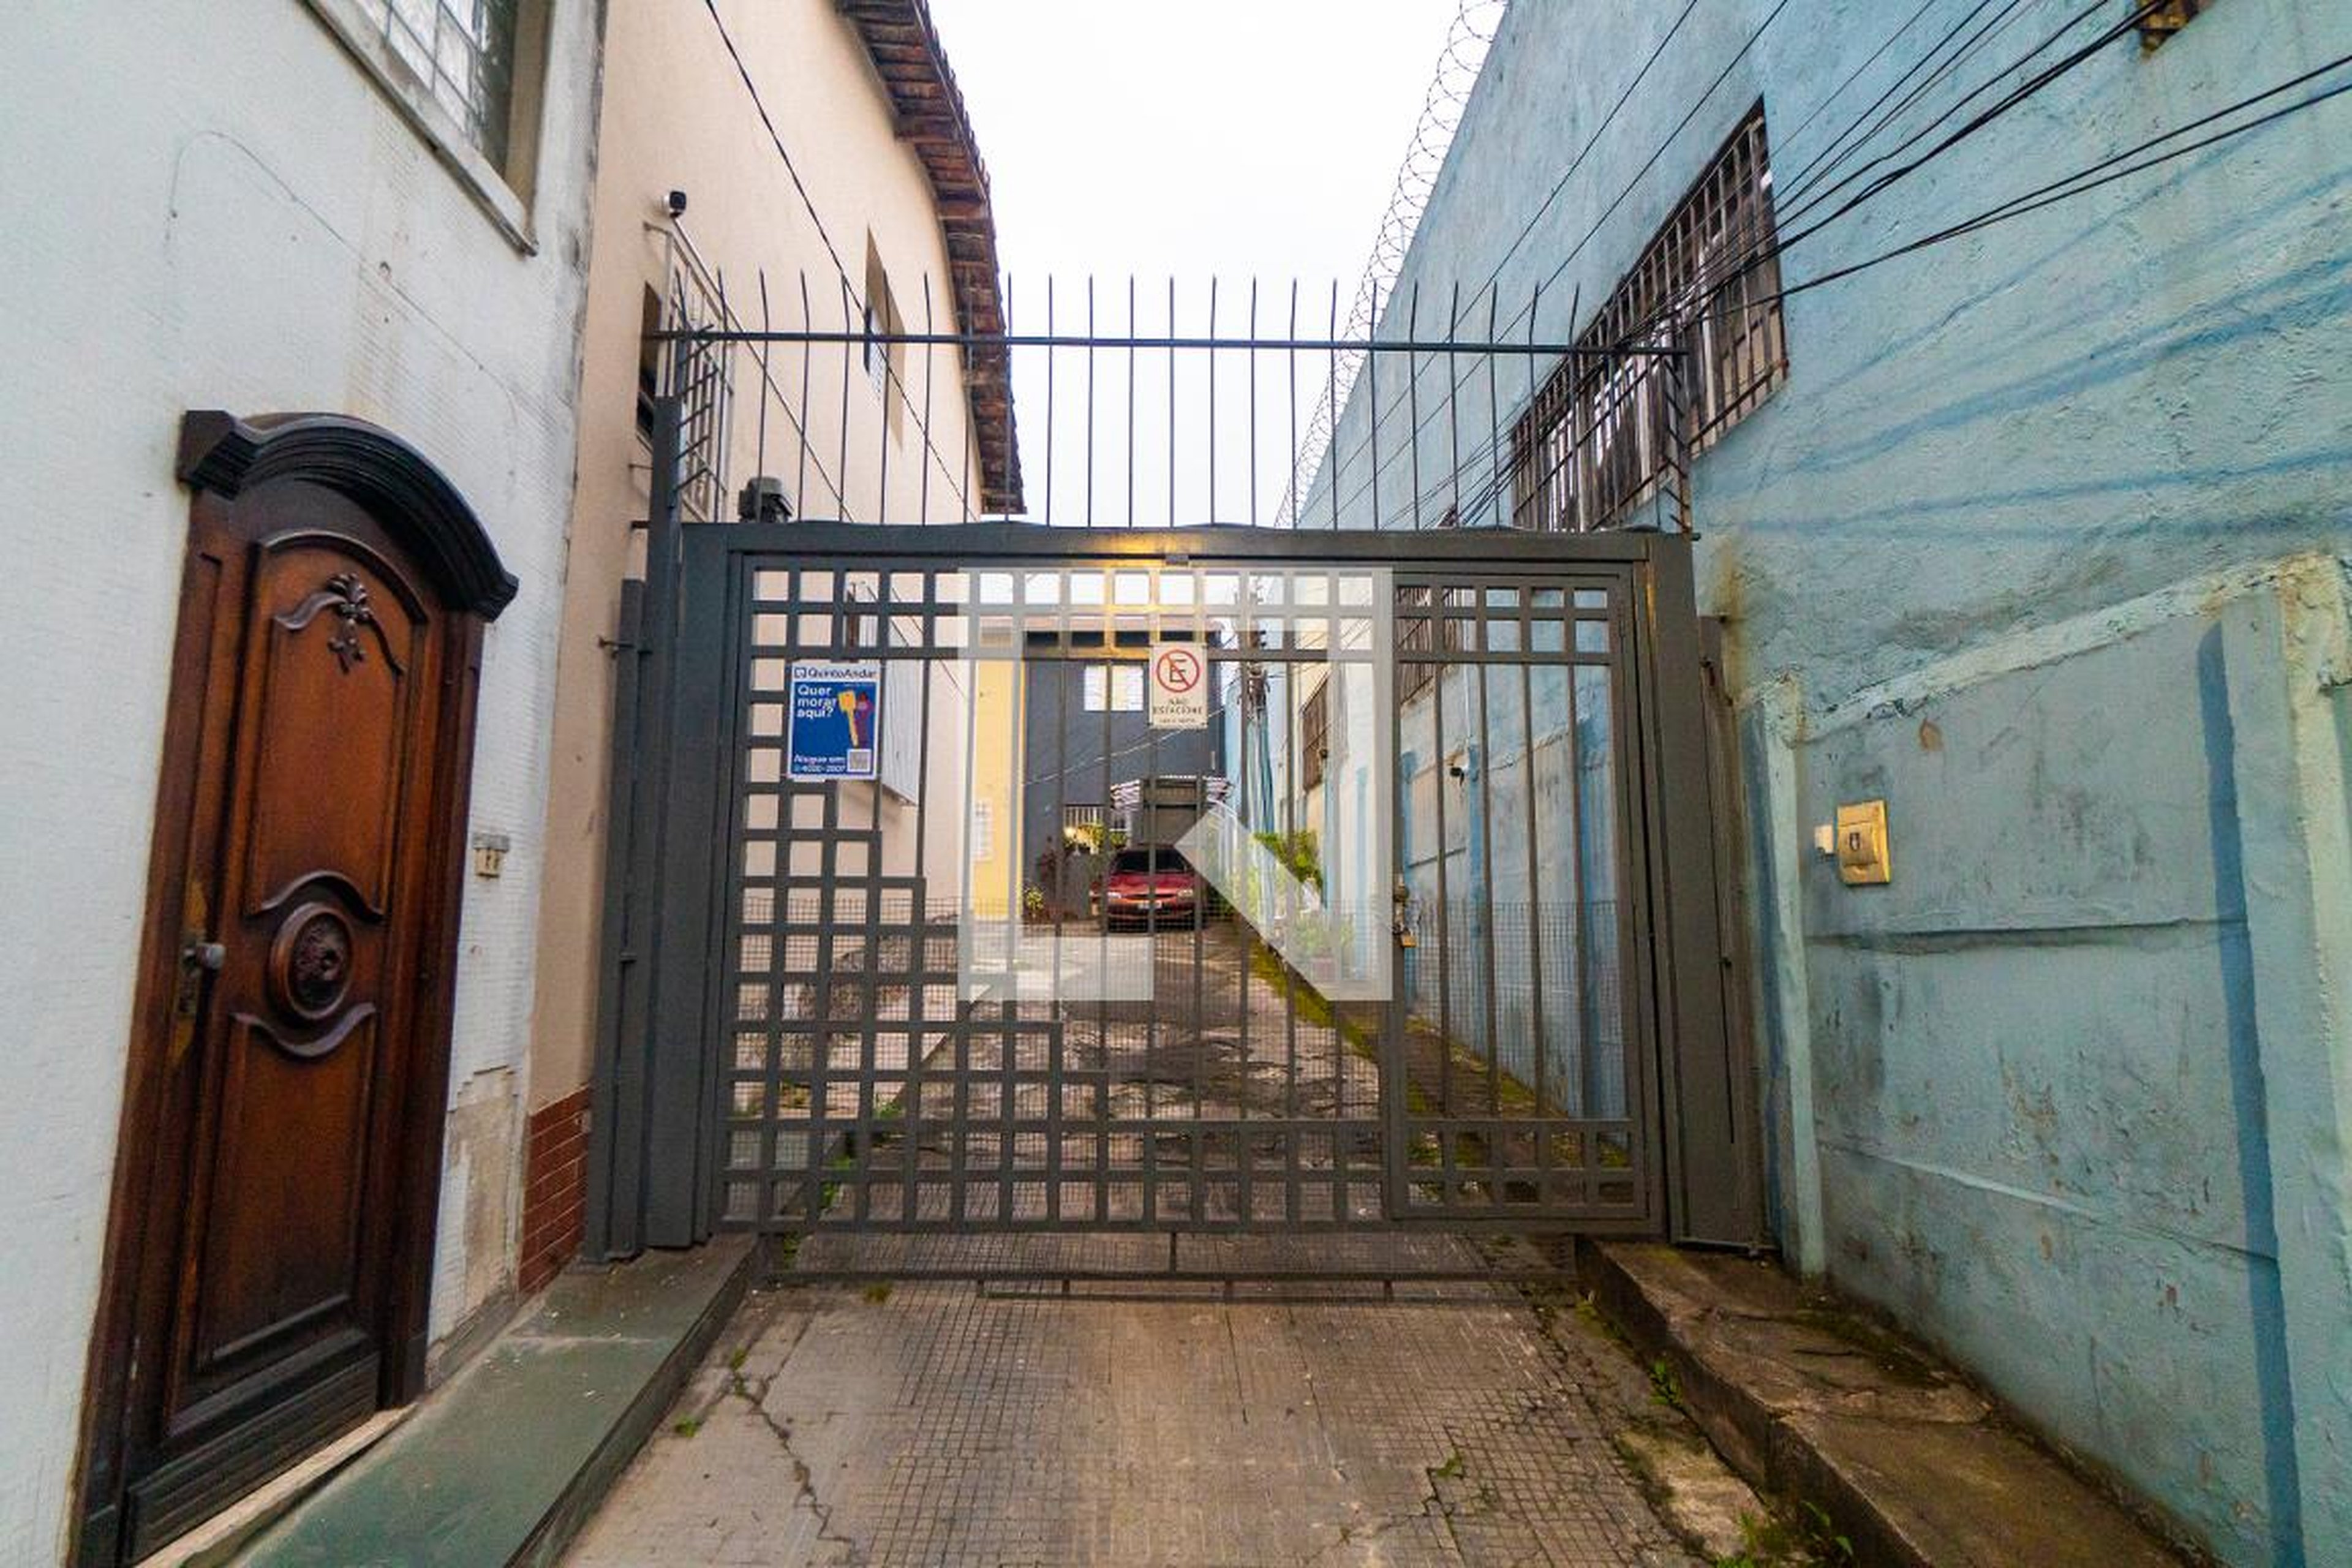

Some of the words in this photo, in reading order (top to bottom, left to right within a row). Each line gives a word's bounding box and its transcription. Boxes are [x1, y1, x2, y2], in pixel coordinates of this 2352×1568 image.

[797, 684, 832, 696] Quer
[797, 698, 837, 707] morar
[797, 706, 834, 719] aqui?
